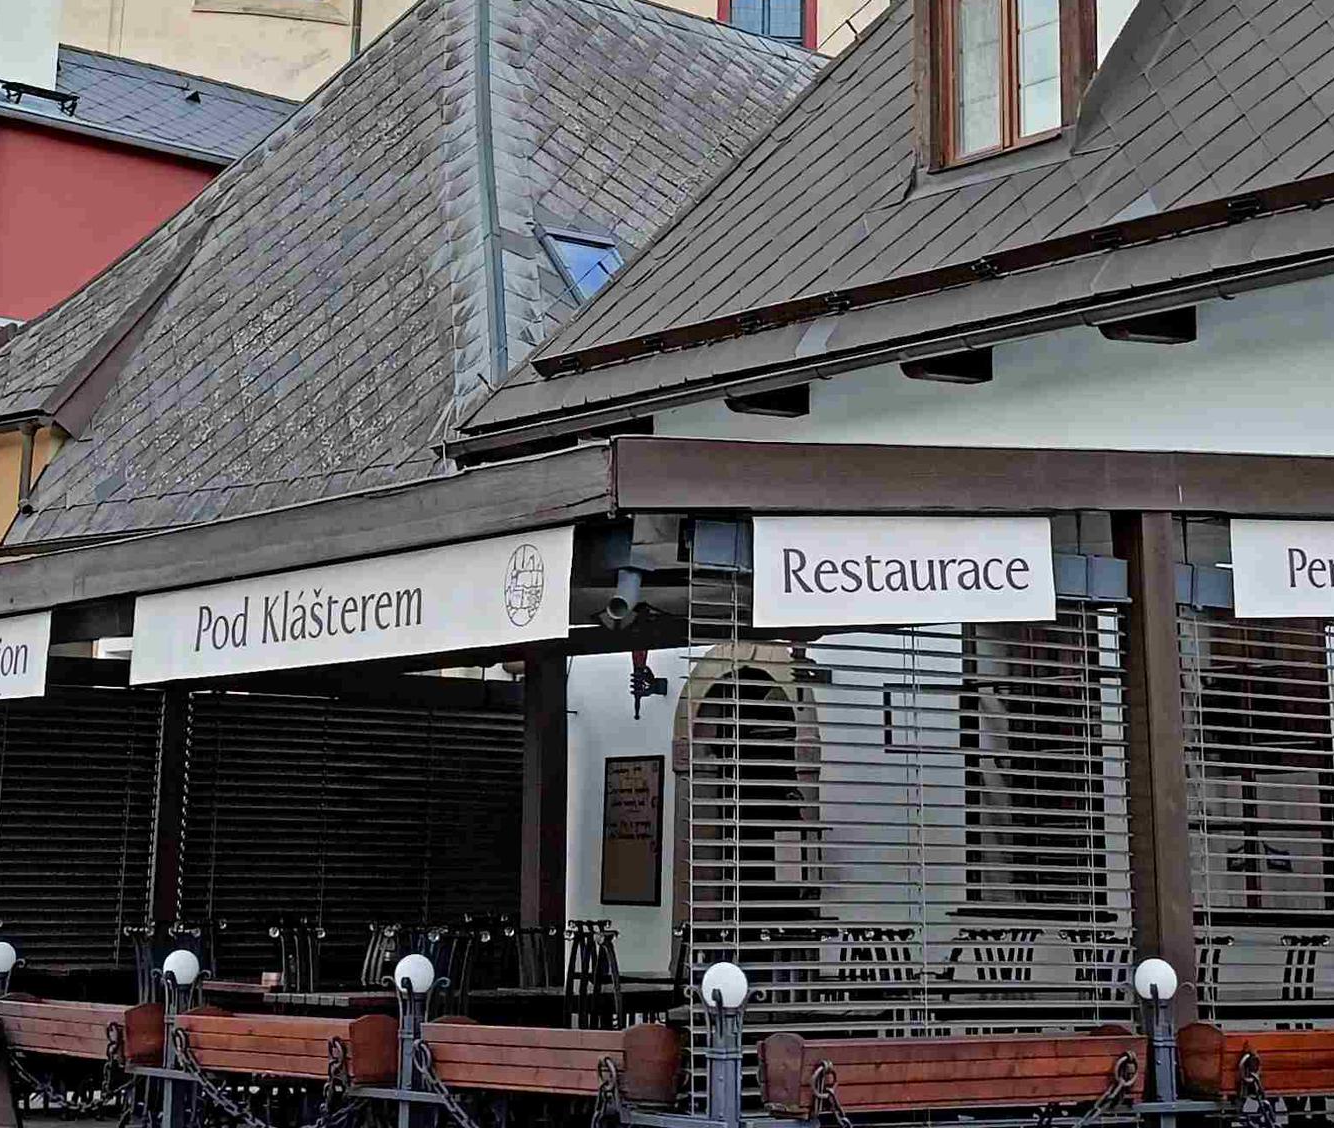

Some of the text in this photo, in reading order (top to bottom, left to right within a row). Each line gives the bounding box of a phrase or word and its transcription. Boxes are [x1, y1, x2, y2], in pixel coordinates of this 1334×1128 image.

[782, 548, 1030, 594] Restaurace
[194, 586, 423, 653] Pod Klášterem
